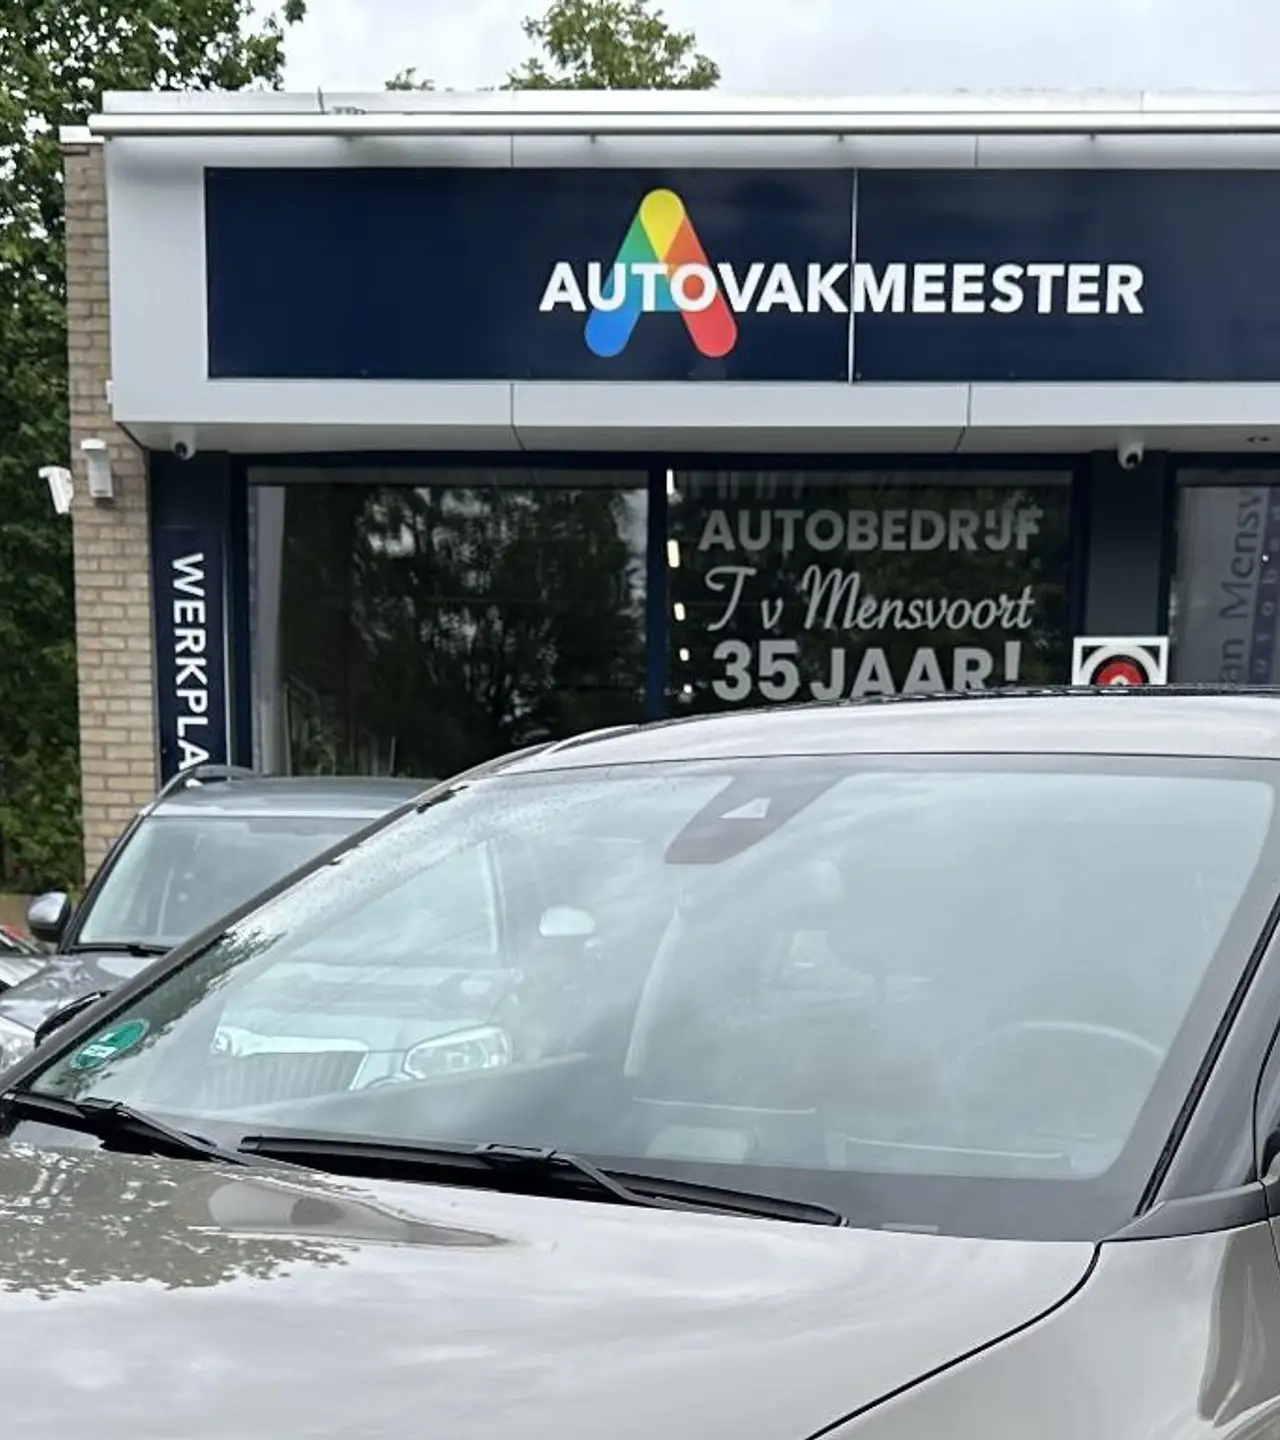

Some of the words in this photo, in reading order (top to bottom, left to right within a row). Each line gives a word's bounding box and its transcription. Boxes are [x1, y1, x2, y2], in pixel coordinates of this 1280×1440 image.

[539, 262, 1145, 314] AUTOVAKMEESTER
[698, 509, 1044, 551] AUTOBEDRIJF
[801, 564, 1036, 631] Mensvoort
[172, 552, 210, 788] WERKPLA
[712, 639, 800, 700] 35
